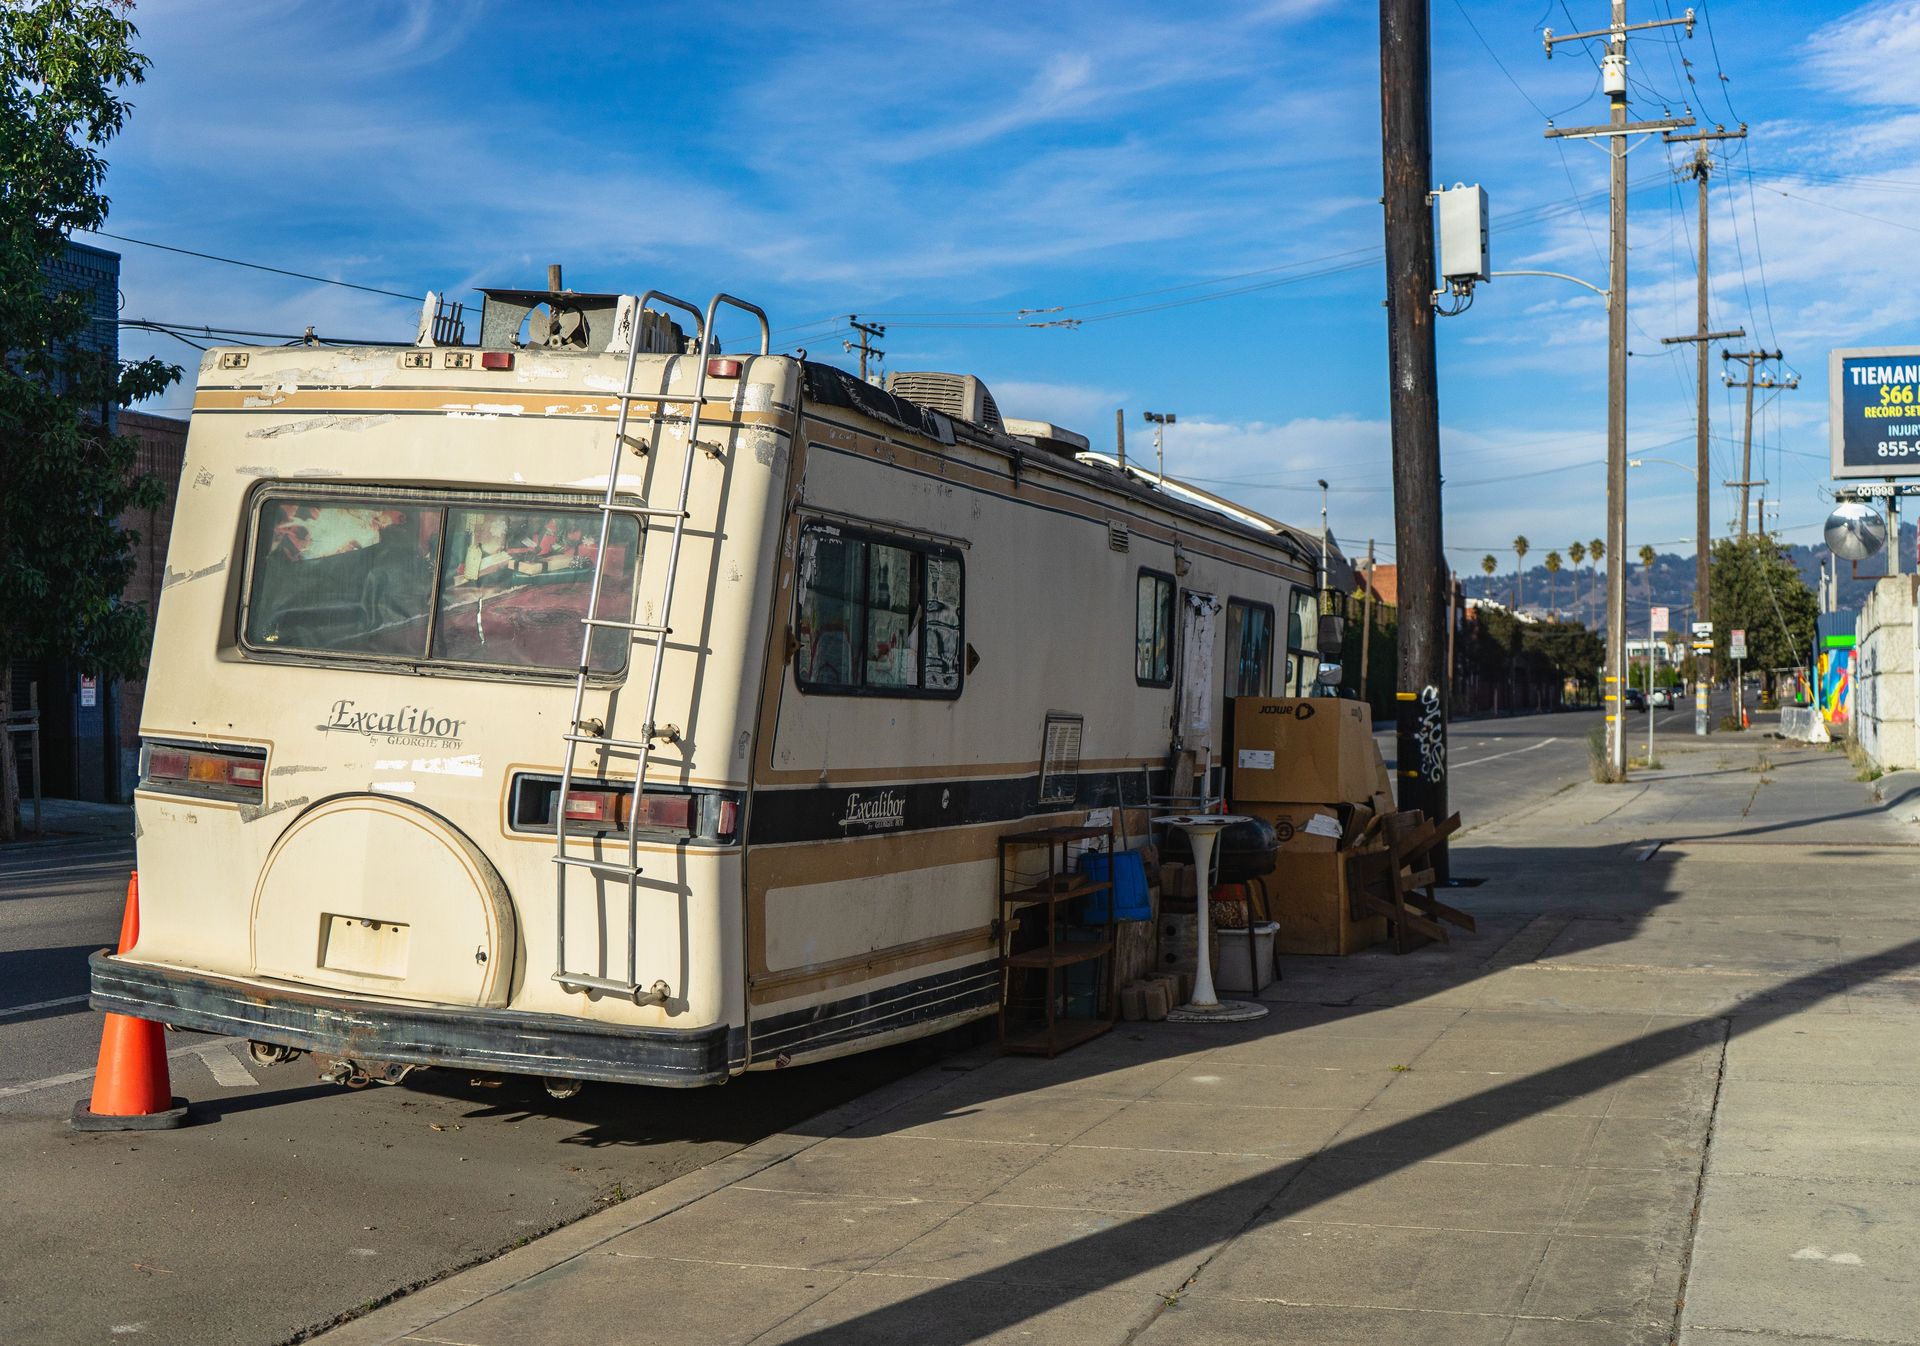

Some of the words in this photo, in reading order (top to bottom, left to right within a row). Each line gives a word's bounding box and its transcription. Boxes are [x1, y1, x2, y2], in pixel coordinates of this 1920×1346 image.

[1850, 365, 1920, 385] TIEMAN
[1880, 384, 1914, 406] $66
[1864, 405, 1903, 418] RECORD
[331, 699, 466, 736] Excalibor
[1258, 704, 1294, 714] amcor
[387, 735, 438, 748] GEORGIE
[442, 740, 464, 750] BOY
[848, 791, 905, 824] Excalibor
